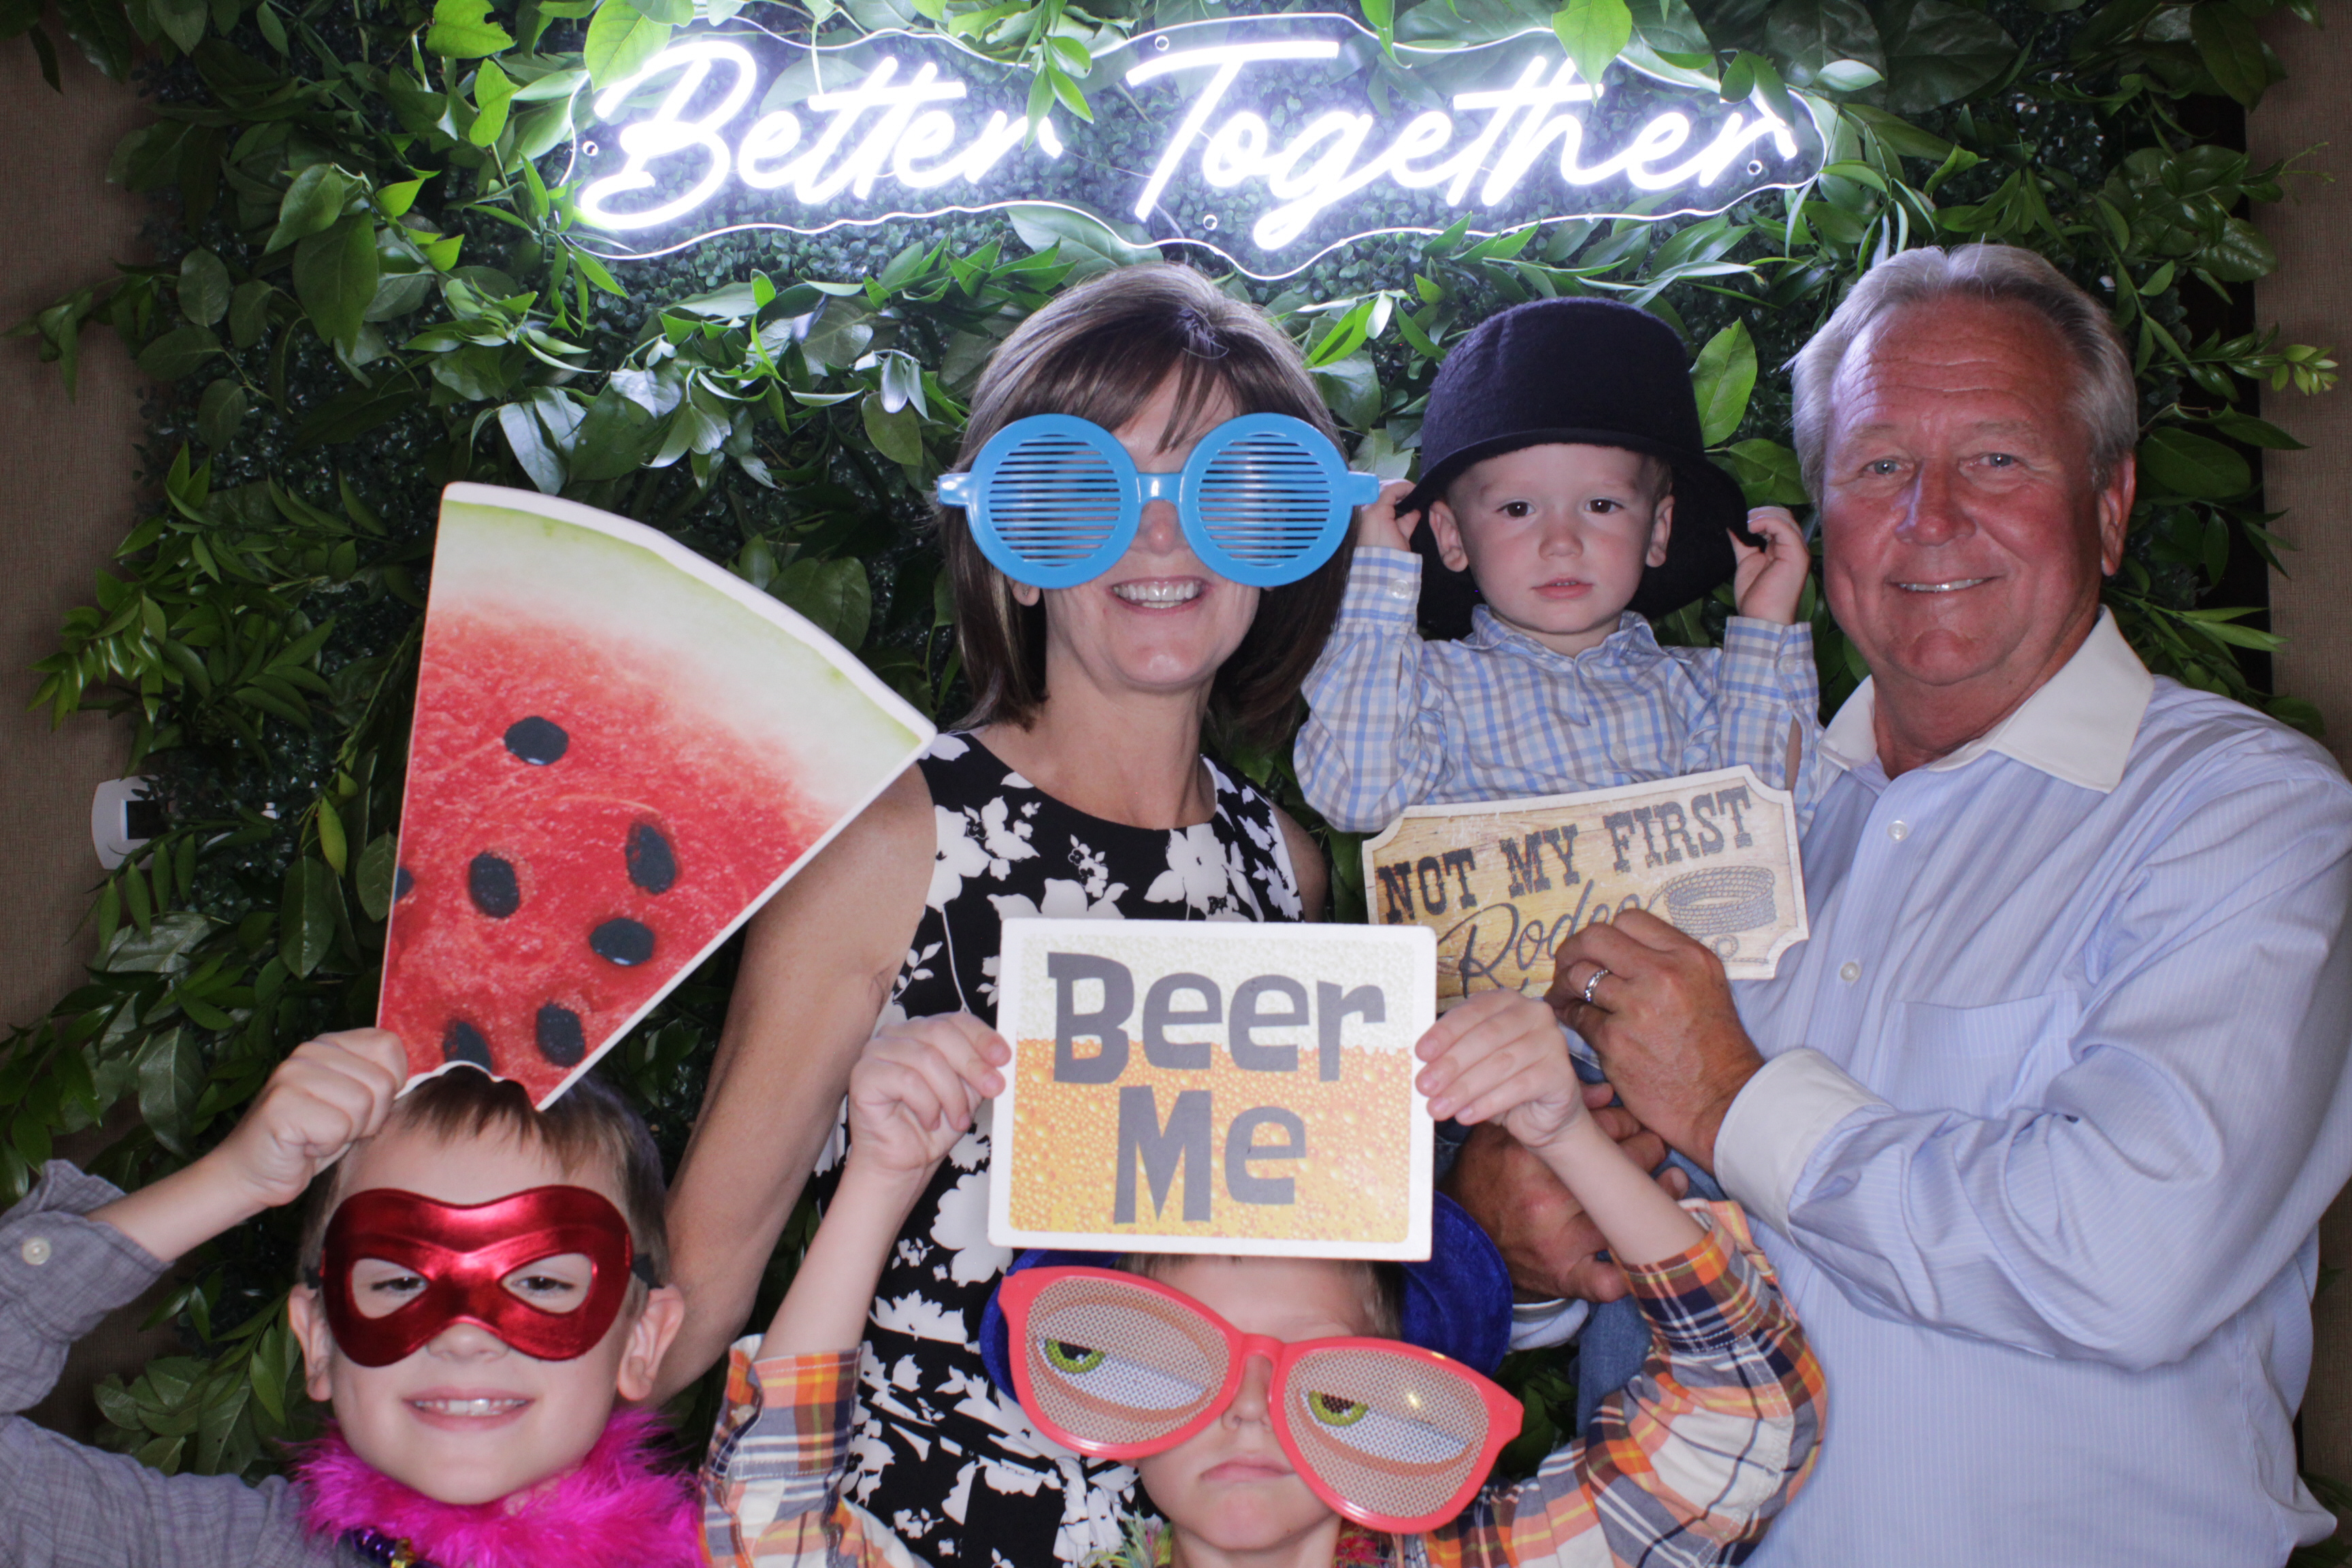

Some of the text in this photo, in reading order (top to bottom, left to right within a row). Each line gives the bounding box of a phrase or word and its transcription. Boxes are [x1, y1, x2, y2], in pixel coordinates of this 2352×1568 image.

[580, 39, 1797, 250] Better Together
[1378, 785, 1752, 924] NOT MY FIRST
[1047, 951, 1386, 1084] Beer
[1113, 1084, 1306, 1225] Me
